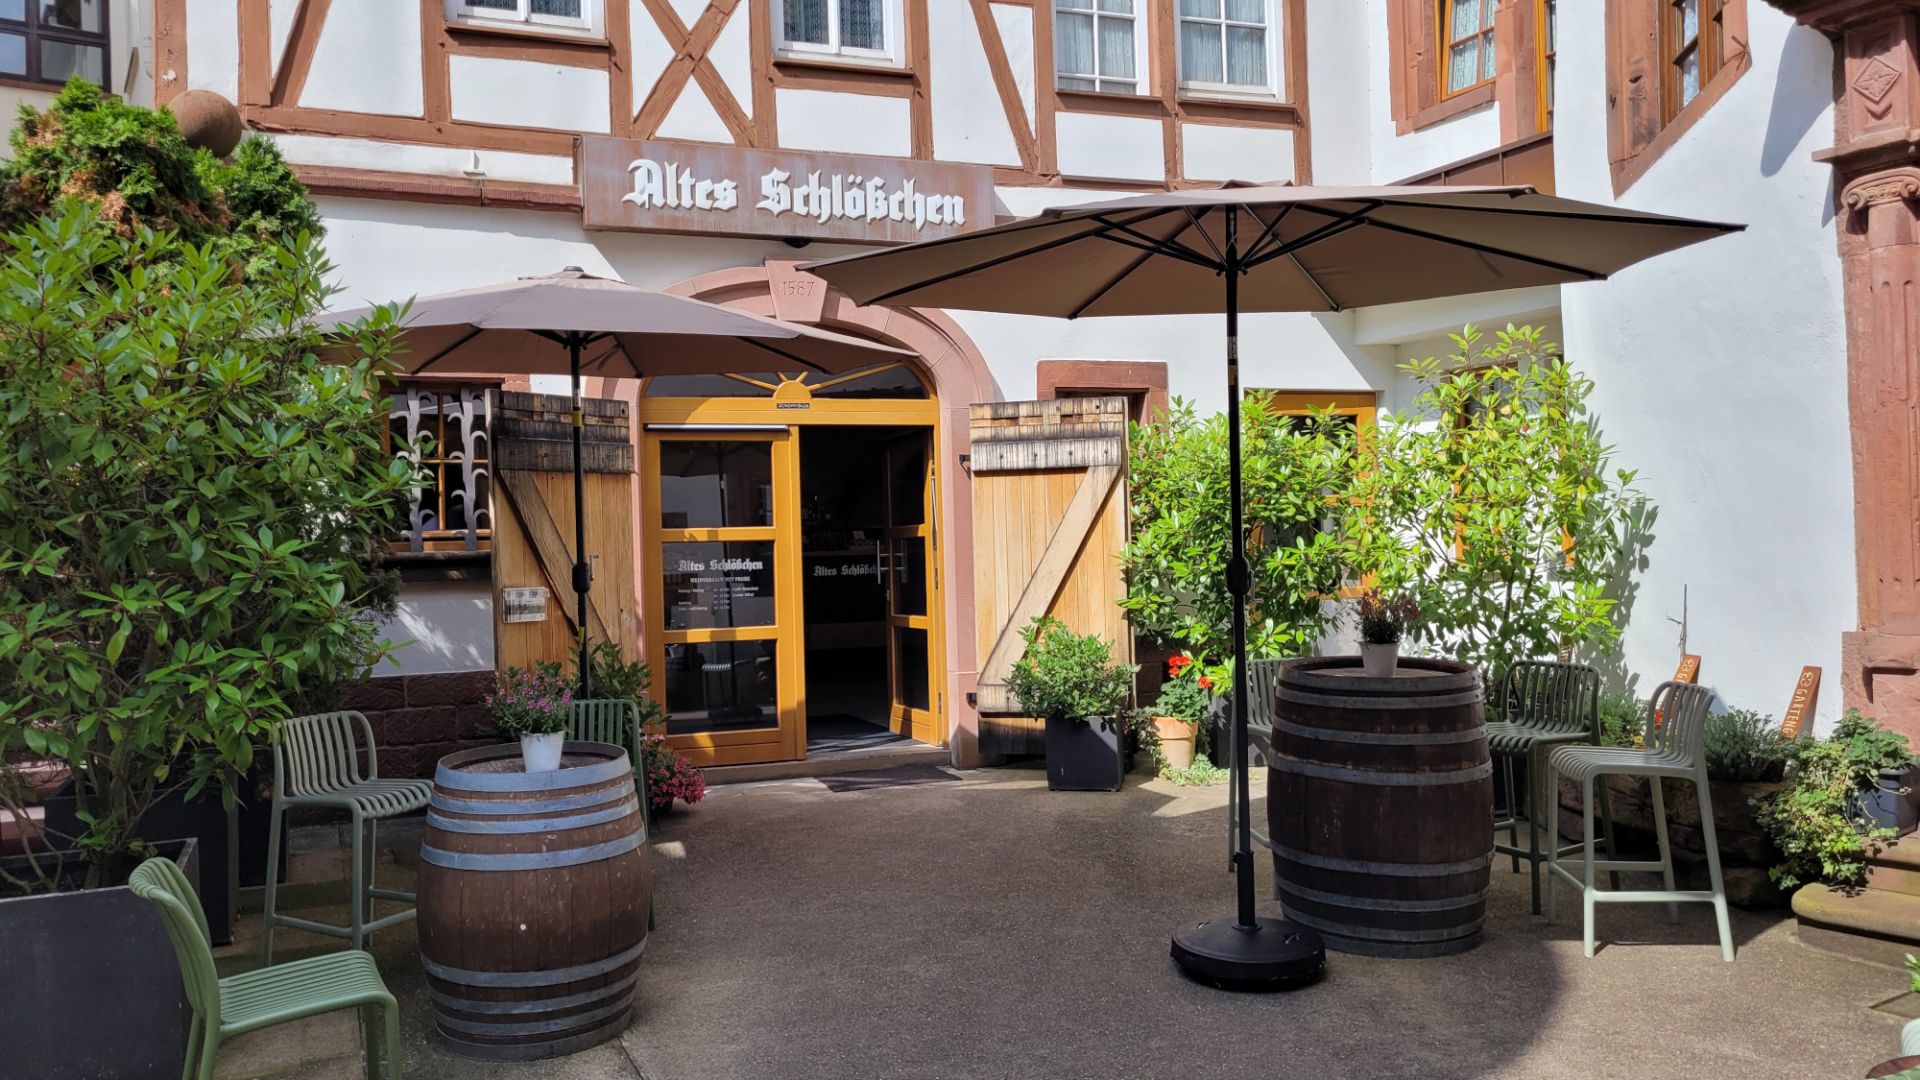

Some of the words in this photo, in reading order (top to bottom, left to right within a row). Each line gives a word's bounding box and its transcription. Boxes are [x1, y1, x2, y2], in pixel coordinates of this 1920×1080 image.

[622, 158, 739, 211] Altes
[756, 166, 967, 231] Schlößchen
[783, 280, 816, 298] 1587
[677, 560, 705, 572] Altes
[709, 558, 763, 572] Schlößchen
[812, 565, 838, 577] Altes
[841, 564, 878, 577] Schlößch
[1782, 688, 1808, 735] GARTENG
